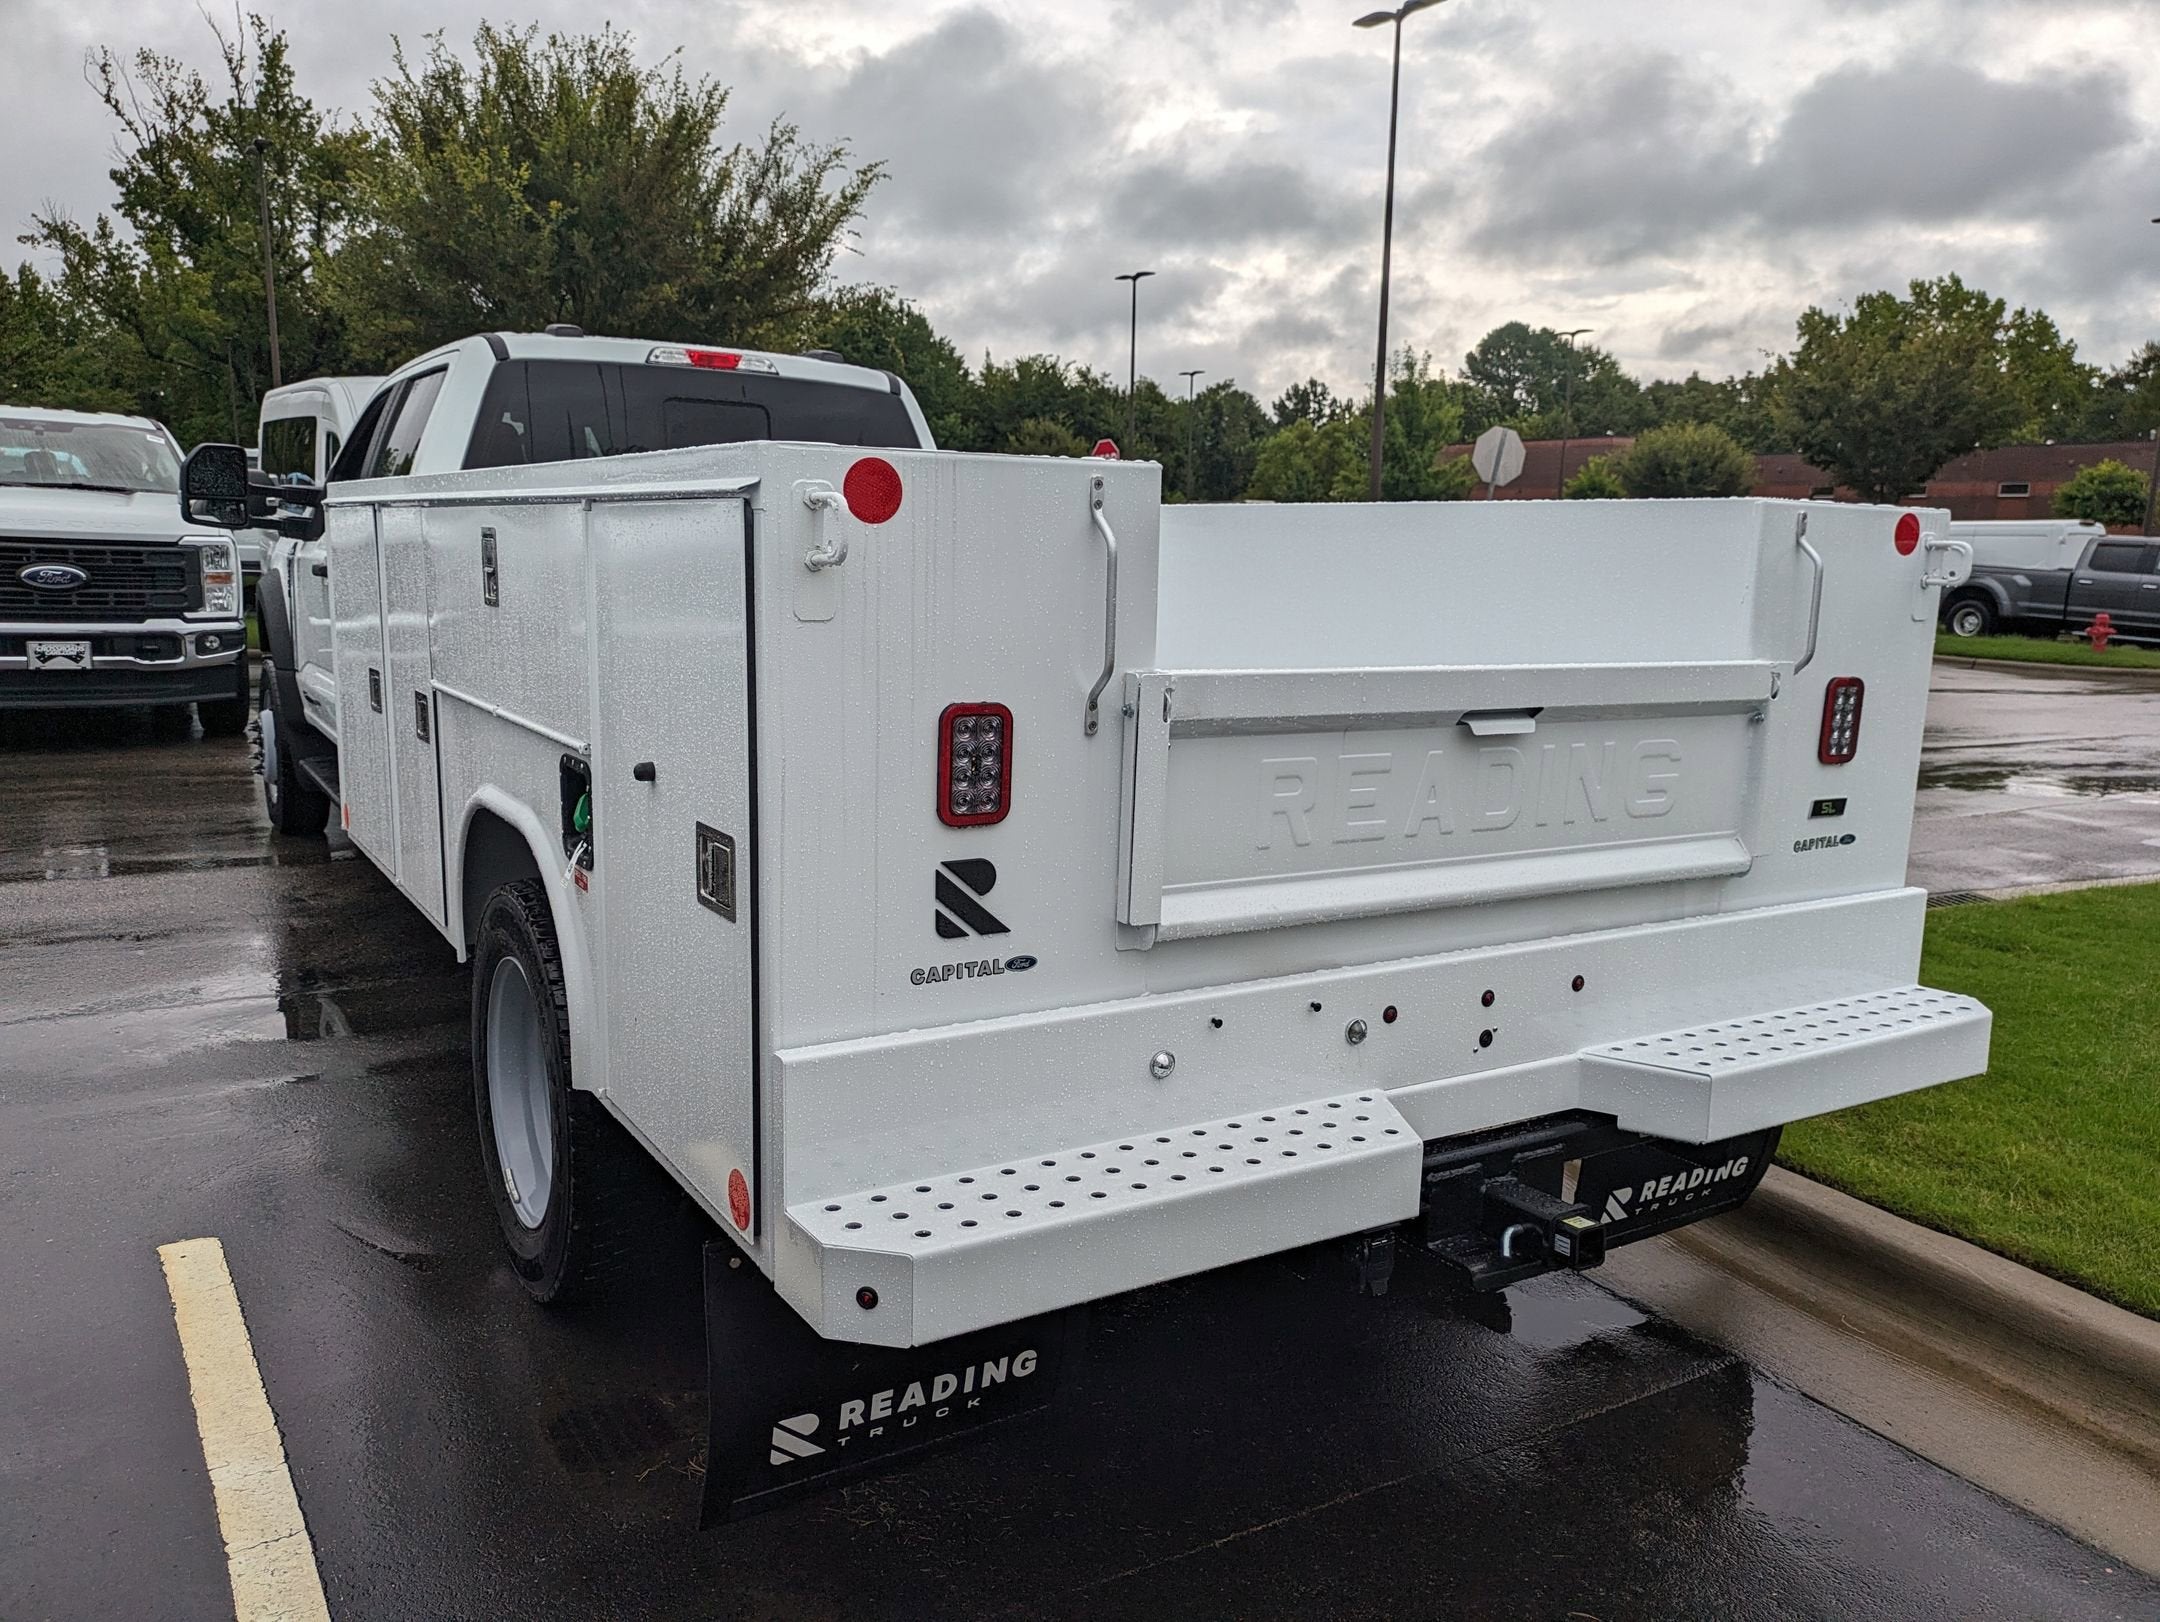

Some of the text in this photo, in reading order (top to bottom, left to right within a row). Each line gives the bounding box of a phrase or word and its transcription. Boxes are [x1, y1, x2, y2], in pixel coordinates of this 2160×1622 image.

[1257, 739, 1681, 850] READING
[1793, 835, 1839, 853] CAPITAL
[910, 958, 1005, 985] CAPITAL
[1635, 1188, 1711, 1216] TRUCK
[1639, 1156, 1749, 1203] READING
[838, 1349, 1037, 1431] READING
[837, 1397, 981, 1447] TRUCK
